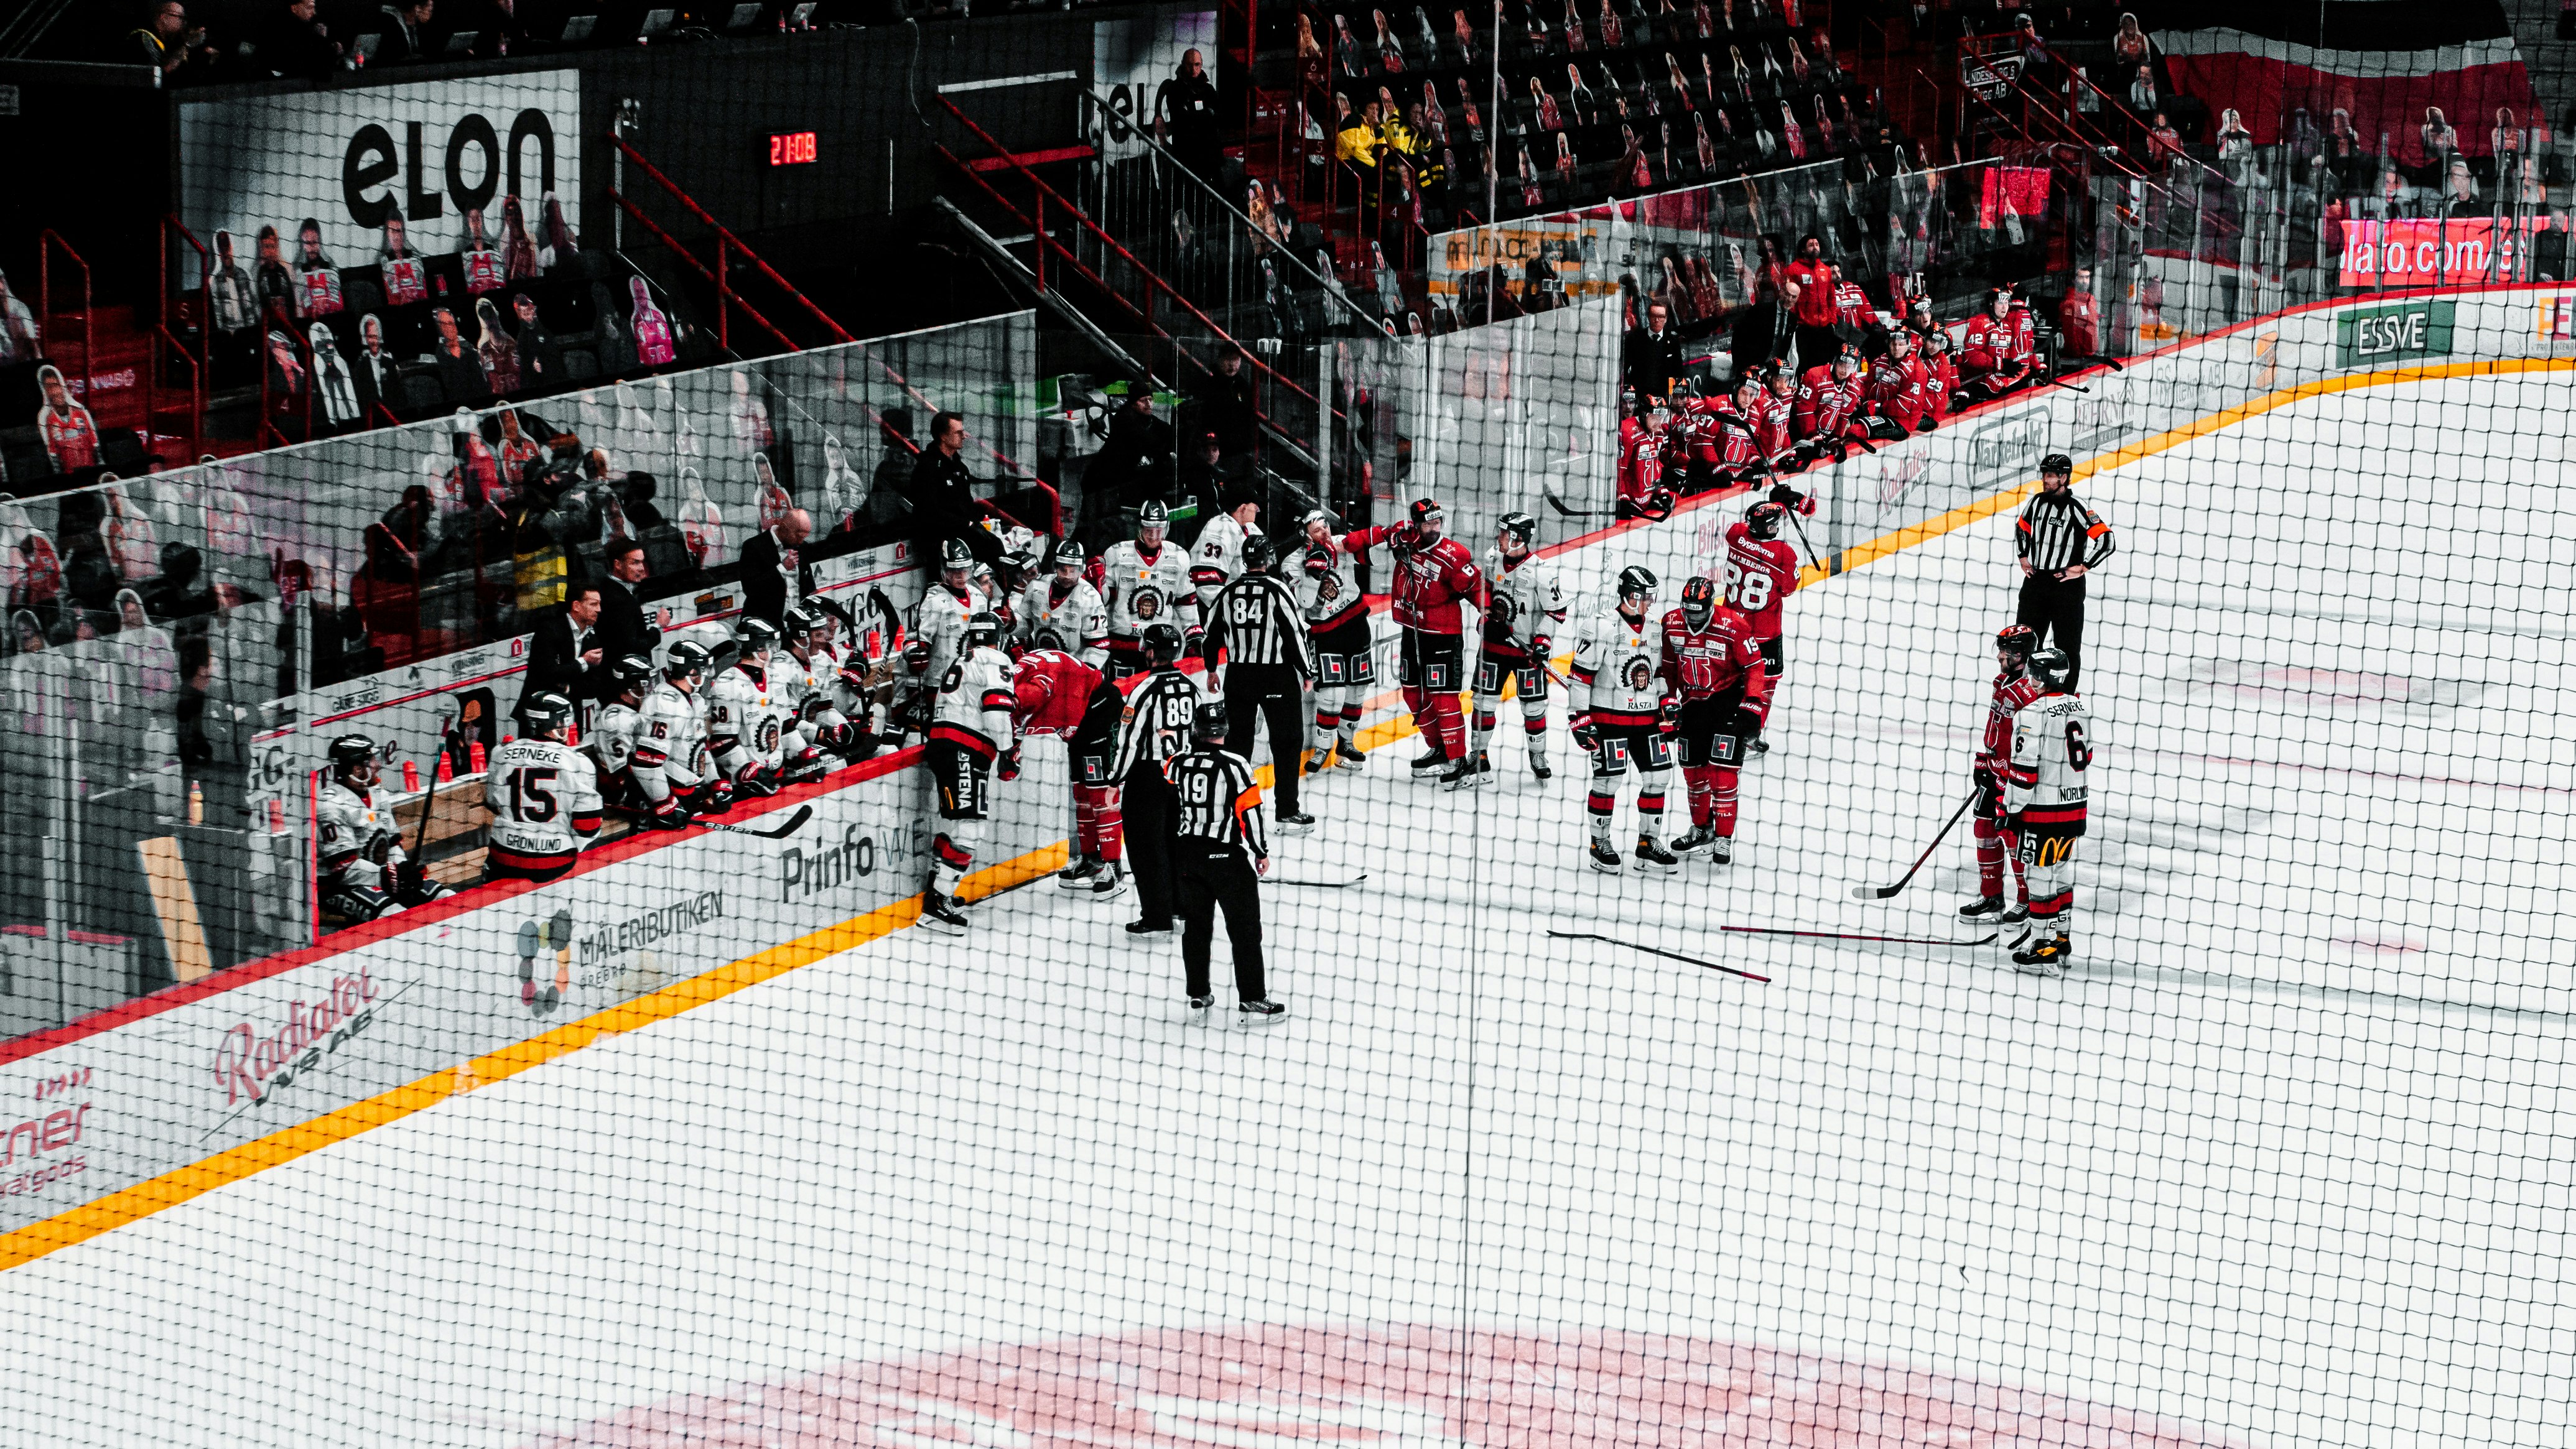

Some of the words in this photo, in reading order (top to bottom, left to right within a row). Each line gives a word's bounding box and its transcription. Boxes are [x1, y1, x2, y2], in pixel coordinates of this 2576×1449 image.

[1994, 83, 2006, 99] AB
[770, 132, 817, 165] 21:08
[1968, 333, 1983, 345] 42
[2358, 313, 2426, 356] ESSVE
[1927, 378, 1943, 392] 29
[1698, 415, 1715, 428] 37
[1876, 445, 1927, 512] Radiator
[1204, 542, 1223, 560] 33
[1724, 562, 1774, 611] 88
[1234, 598, 1263, 624] 84
[1328, 598, 1351, 615] RASTA
[1519, 601, 1526, 615] A
[1743, 636, 1759, 655] 19
[1166, 697, 1193, 726] 89
[1627, 701, 1652, 710] RASTA
[2047, 700, 2085, 718] SERNEKE
[653, 721, 667, 740] 16
[504, 748, 561, 764] SERNEKE
[2015, 736, 2024, 753] 6
[2065, 720, 2088, 772] 6
[508, 767, 557, 823] 15
[958, 759, 972, 808] STENA
[1183, 773, 1208, 803] 19
[782, 823, 873, 904] Prinfo
[580, 887, 723, 967] MÅLERIBUTIKEN
[215, 965, 380, 1106] Radiator
[328, 1008, 372, 1053] AB
